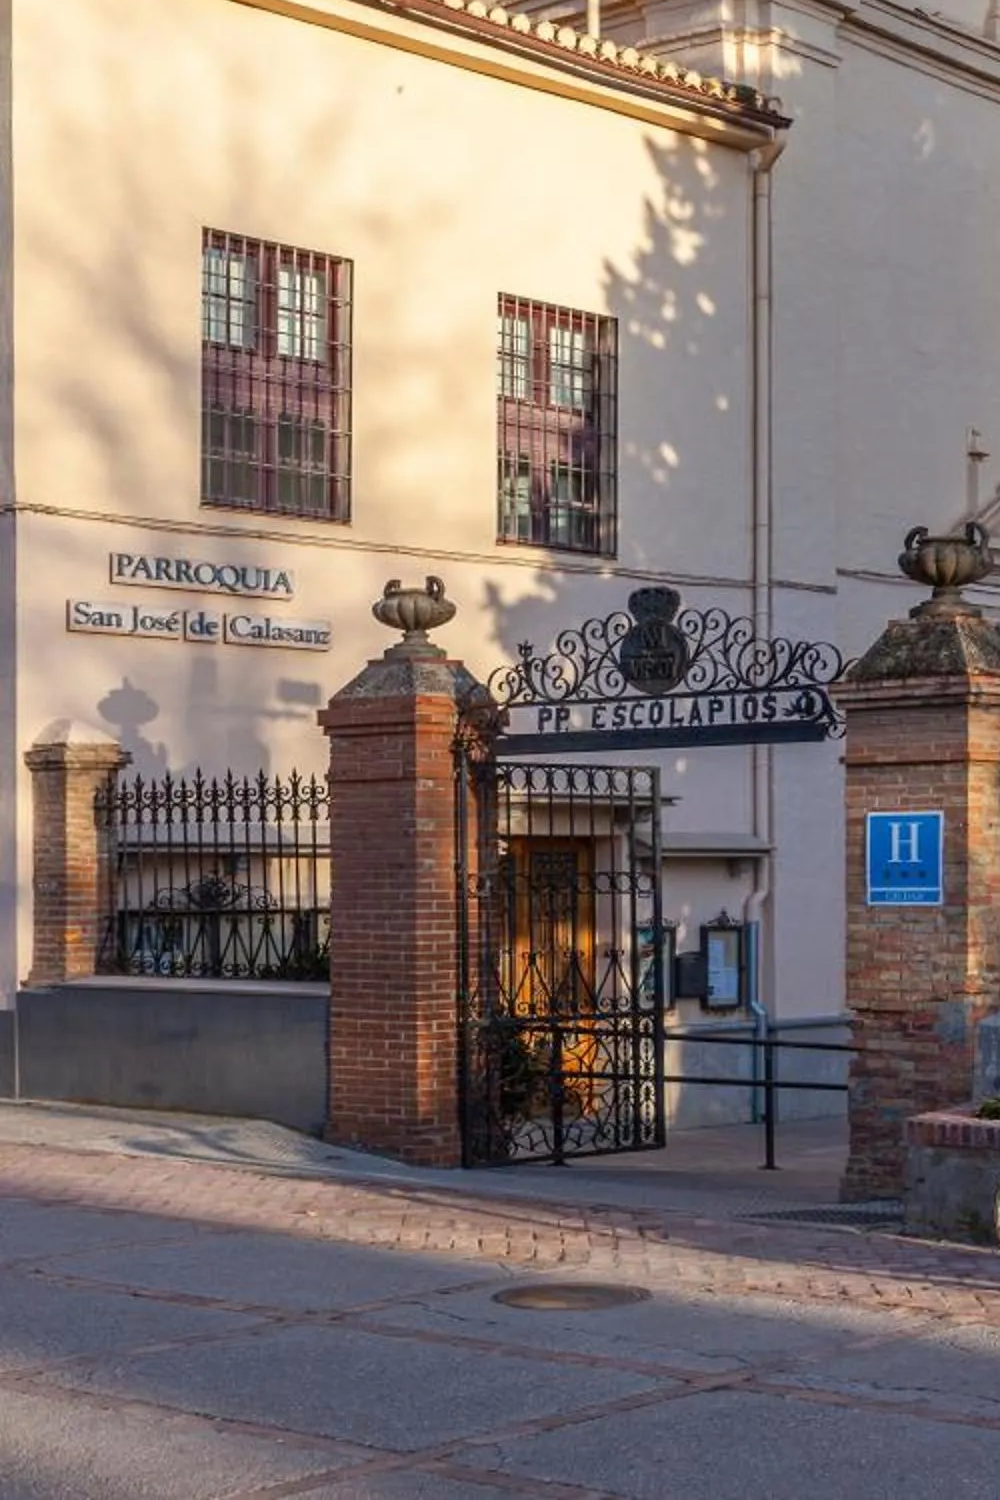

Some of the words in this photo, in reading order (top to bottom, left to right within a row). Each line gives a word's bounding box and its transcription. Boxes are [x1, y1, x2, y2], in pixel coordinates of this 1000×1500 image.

[114, 552, 294, 594] PARROQUIA
[73, 601, 123, 628] San
[129, 605, 180, 633] José
[189, 611, 219, 636] de
[229, 614, 331, 645] Calasanz
[591, 694, 777, 730] ESCOLAPIOS
[887, 821, 923, 863] H
